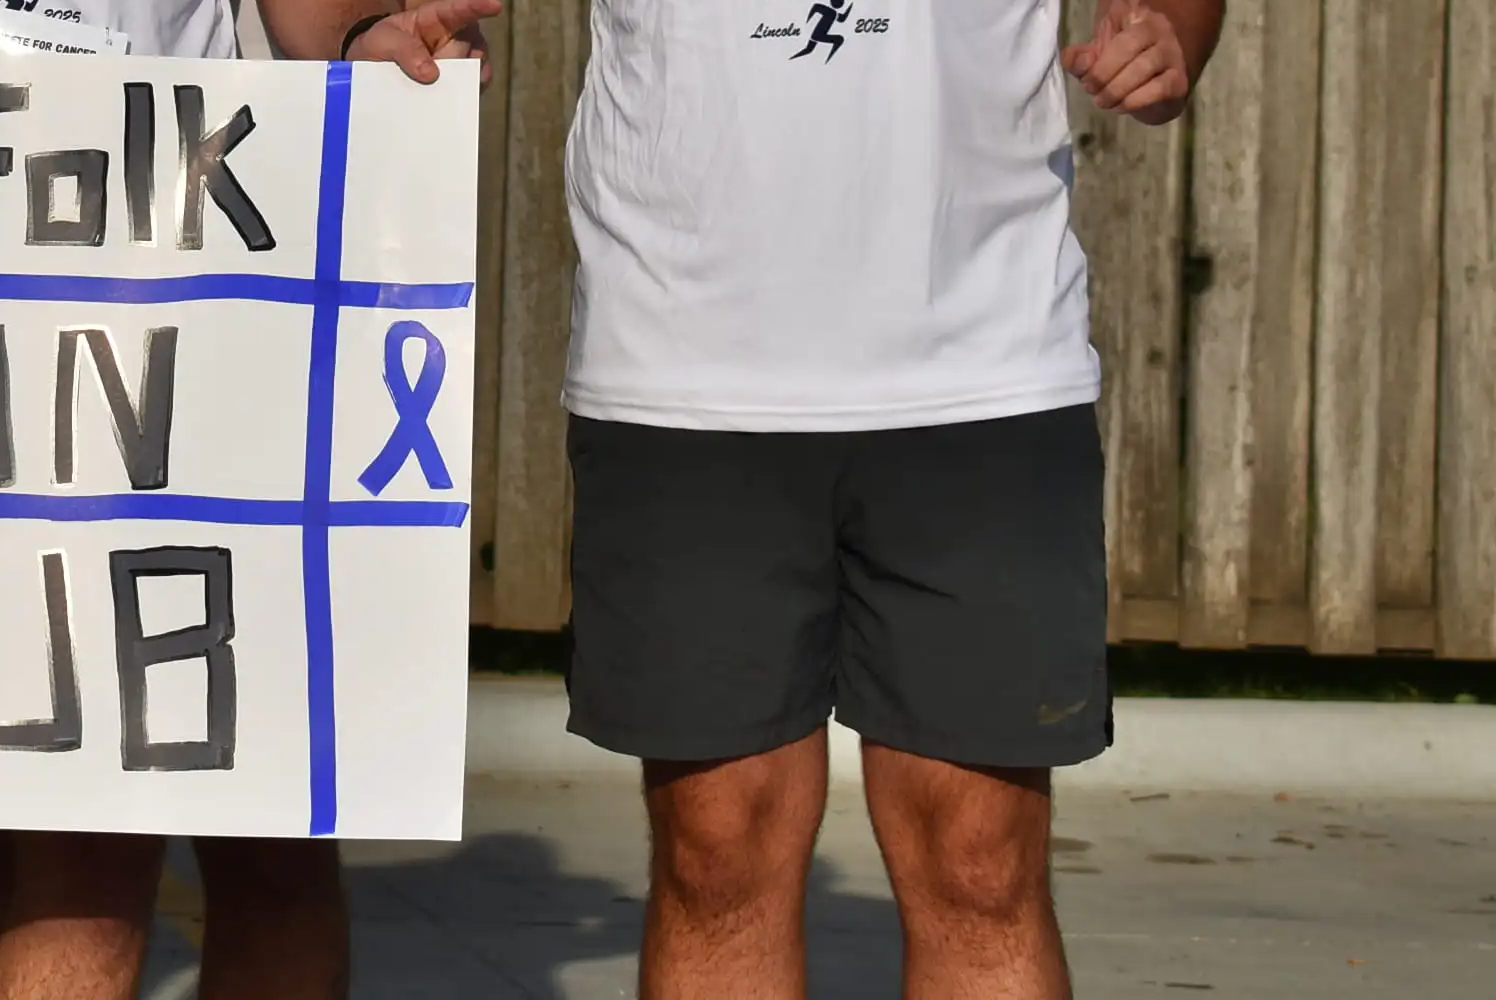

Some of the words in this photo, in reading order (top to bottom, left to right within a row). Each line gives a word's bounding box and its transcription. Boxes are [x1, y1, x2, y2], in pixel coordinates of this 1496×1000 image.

[751, 23, 801, 39] Lincoln
[855, 18, 890, 34] 2025
[32, 38, 53, 52] FOR
